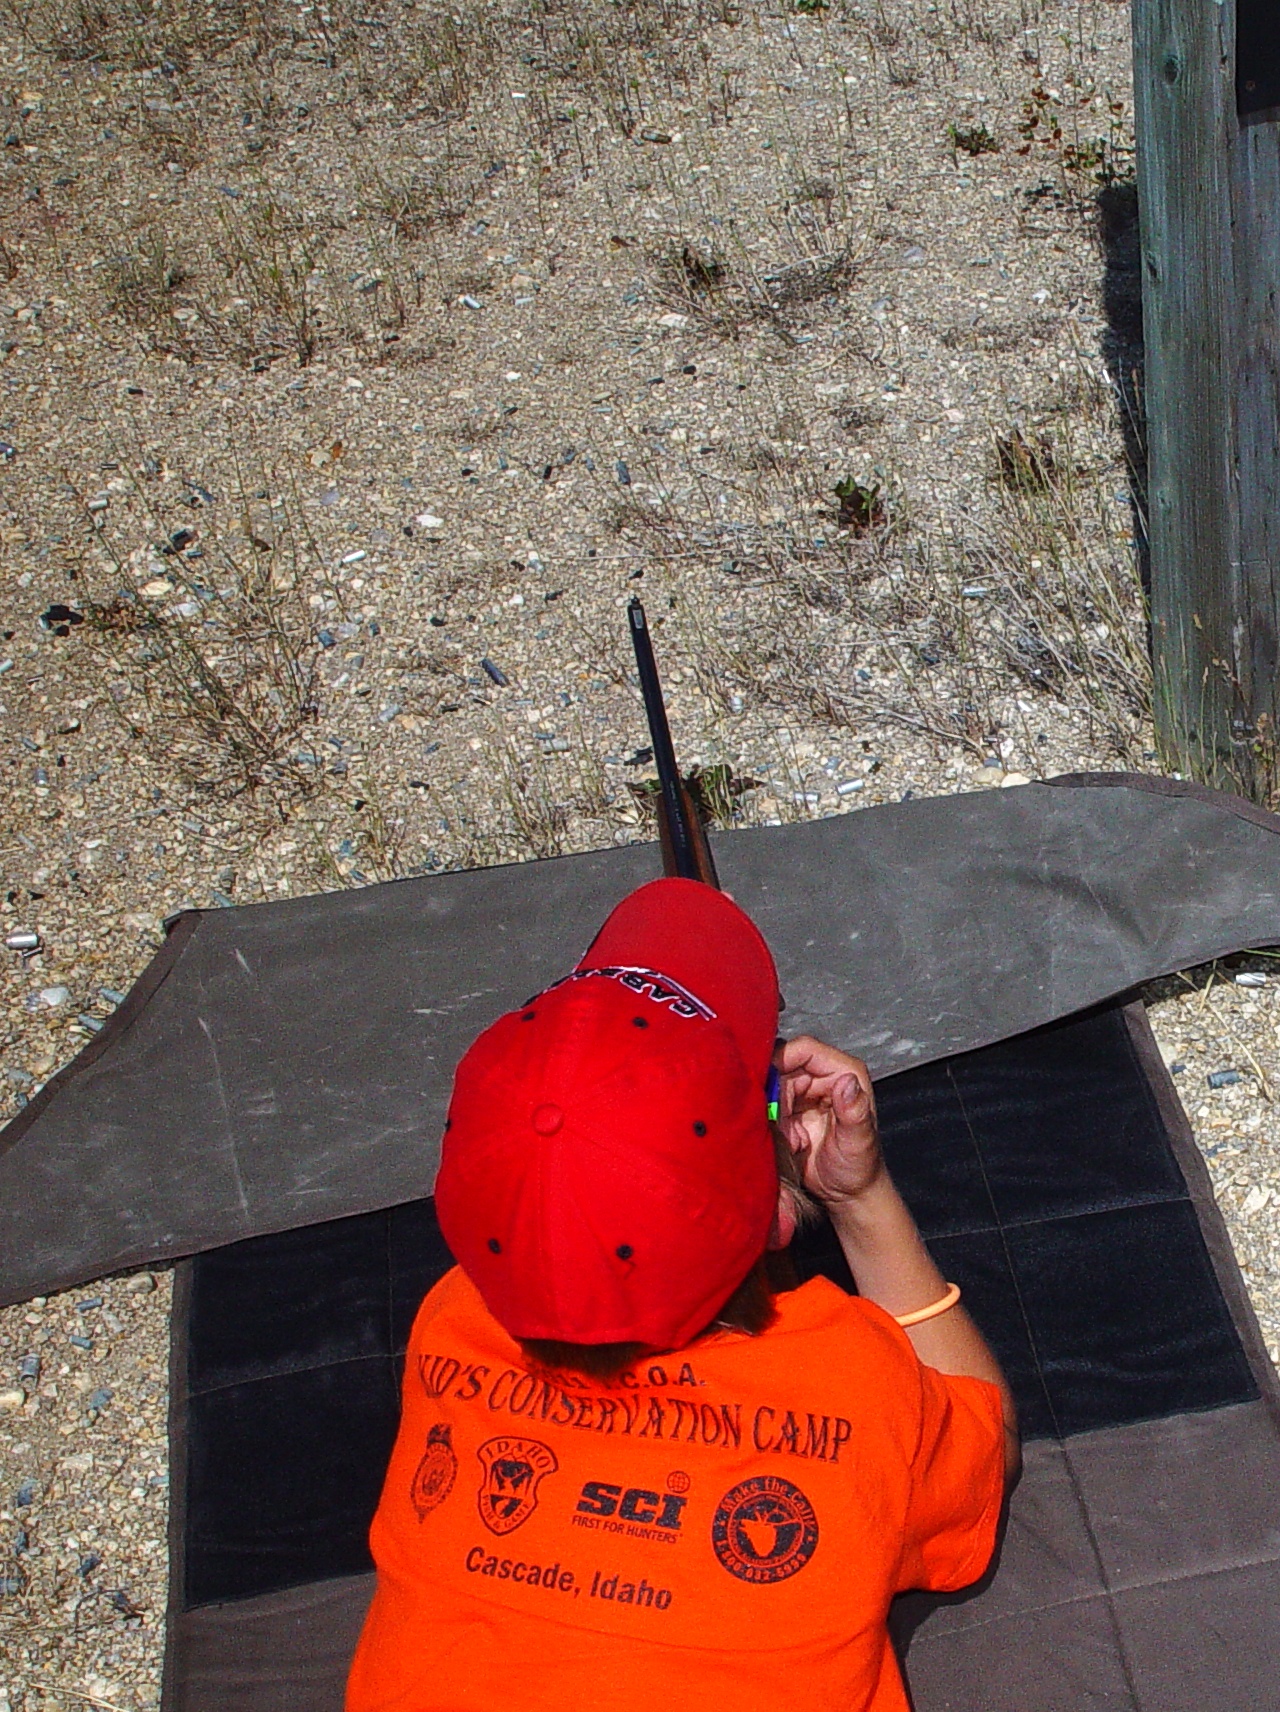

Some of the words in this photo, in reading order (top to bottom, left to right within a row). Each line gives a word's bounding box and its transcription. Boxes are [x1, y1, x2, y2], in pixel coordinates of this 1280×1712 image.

[488, 1369, 743, 1450] CONSERVATION
[753, 1405, 853, 1463] CAMP
[485, 1440, 551, 1469] IDAHO
[576, 1481, 688, 1530] SCI
[720, 1482, 759, 1513] Make
[764, 1476, 788, 1493] the
[571, 1515, 601, 1529] FIRST
[603, 1520, 625, 1534] FOR
[626, 1525, 678, 1544] HUNTERS
[465, 1546, 581, 1599] Cascade,
[590, 1570, 673, 1611] Idaho
